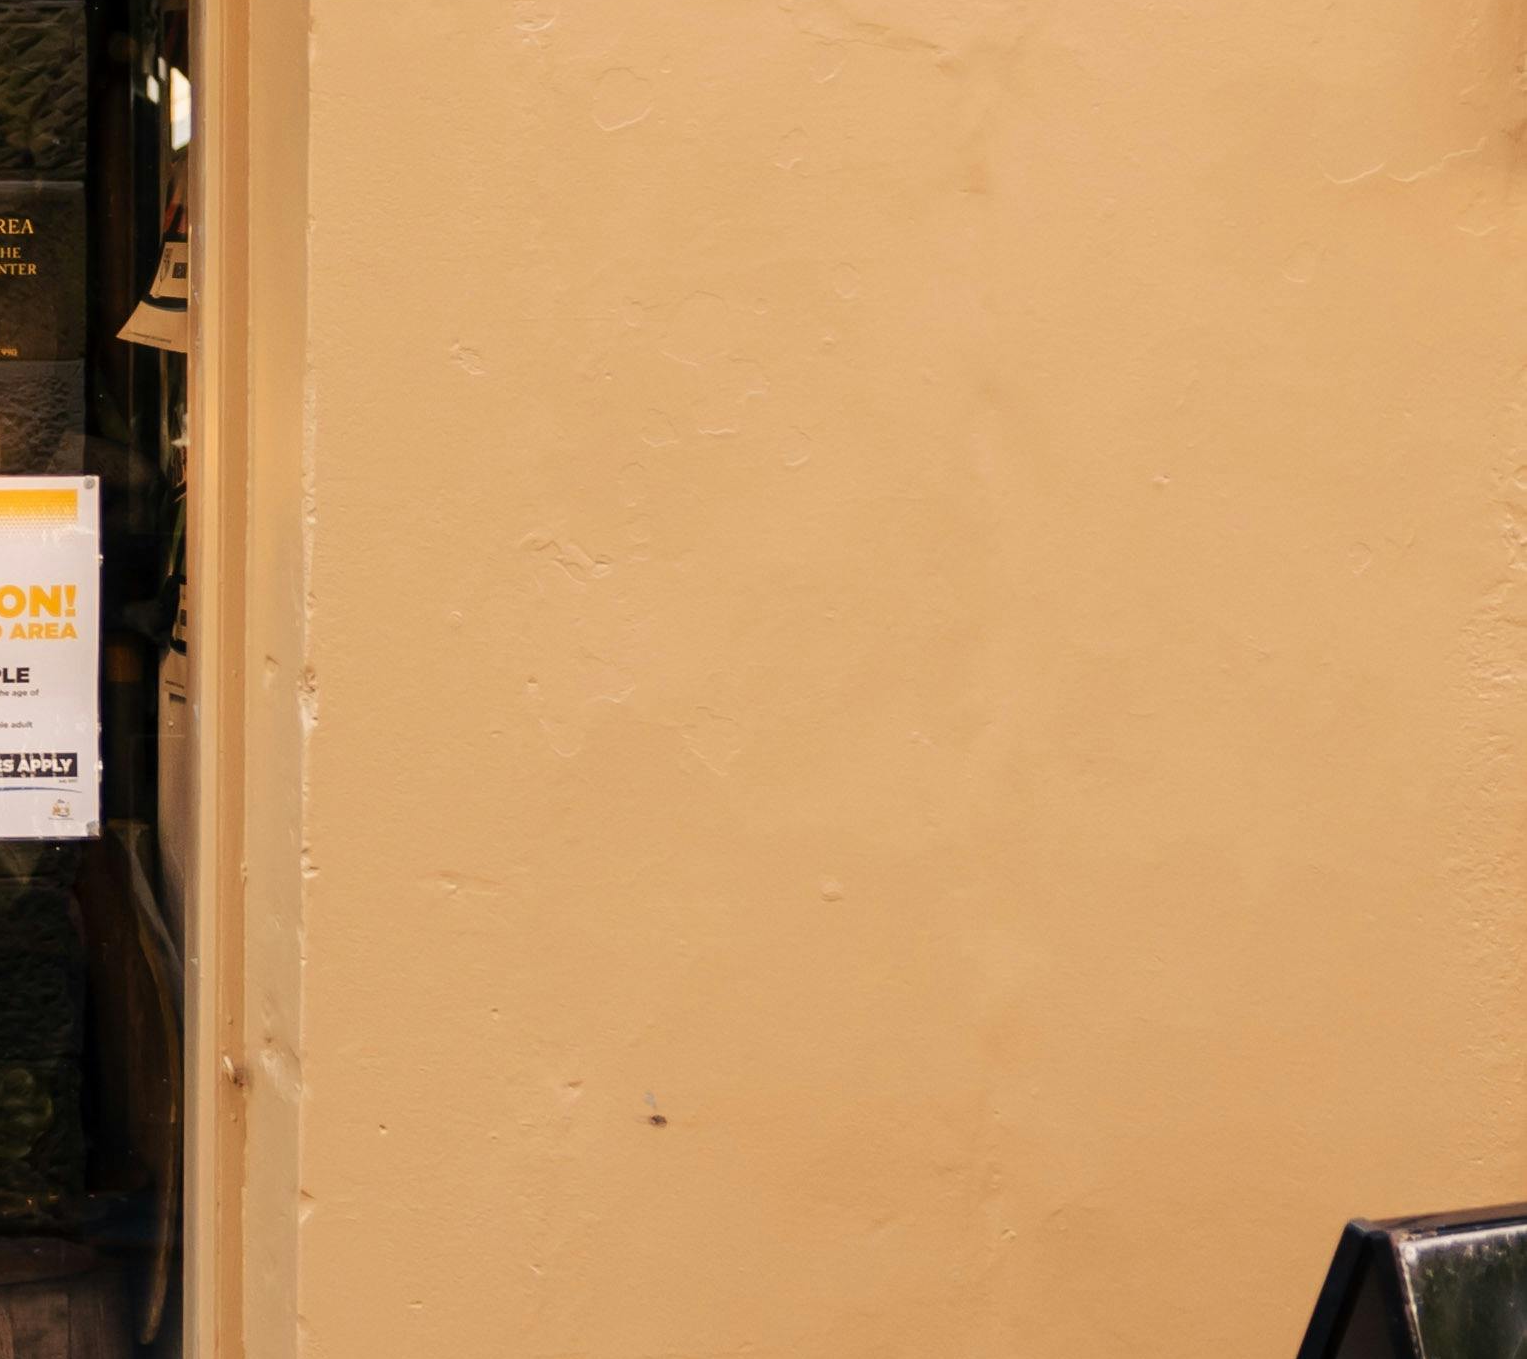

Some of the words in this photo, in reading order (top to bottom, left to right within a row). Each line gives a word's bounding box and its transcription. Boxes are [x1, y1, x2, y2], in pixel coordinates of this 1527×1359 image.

[9, 622, 78, 640] AREA
[12, 690, 27, 699] age
[30, 689, 40, 697] of
[10, 721, 33, 729] adult
[18, 758, 73, 774] APPLY
